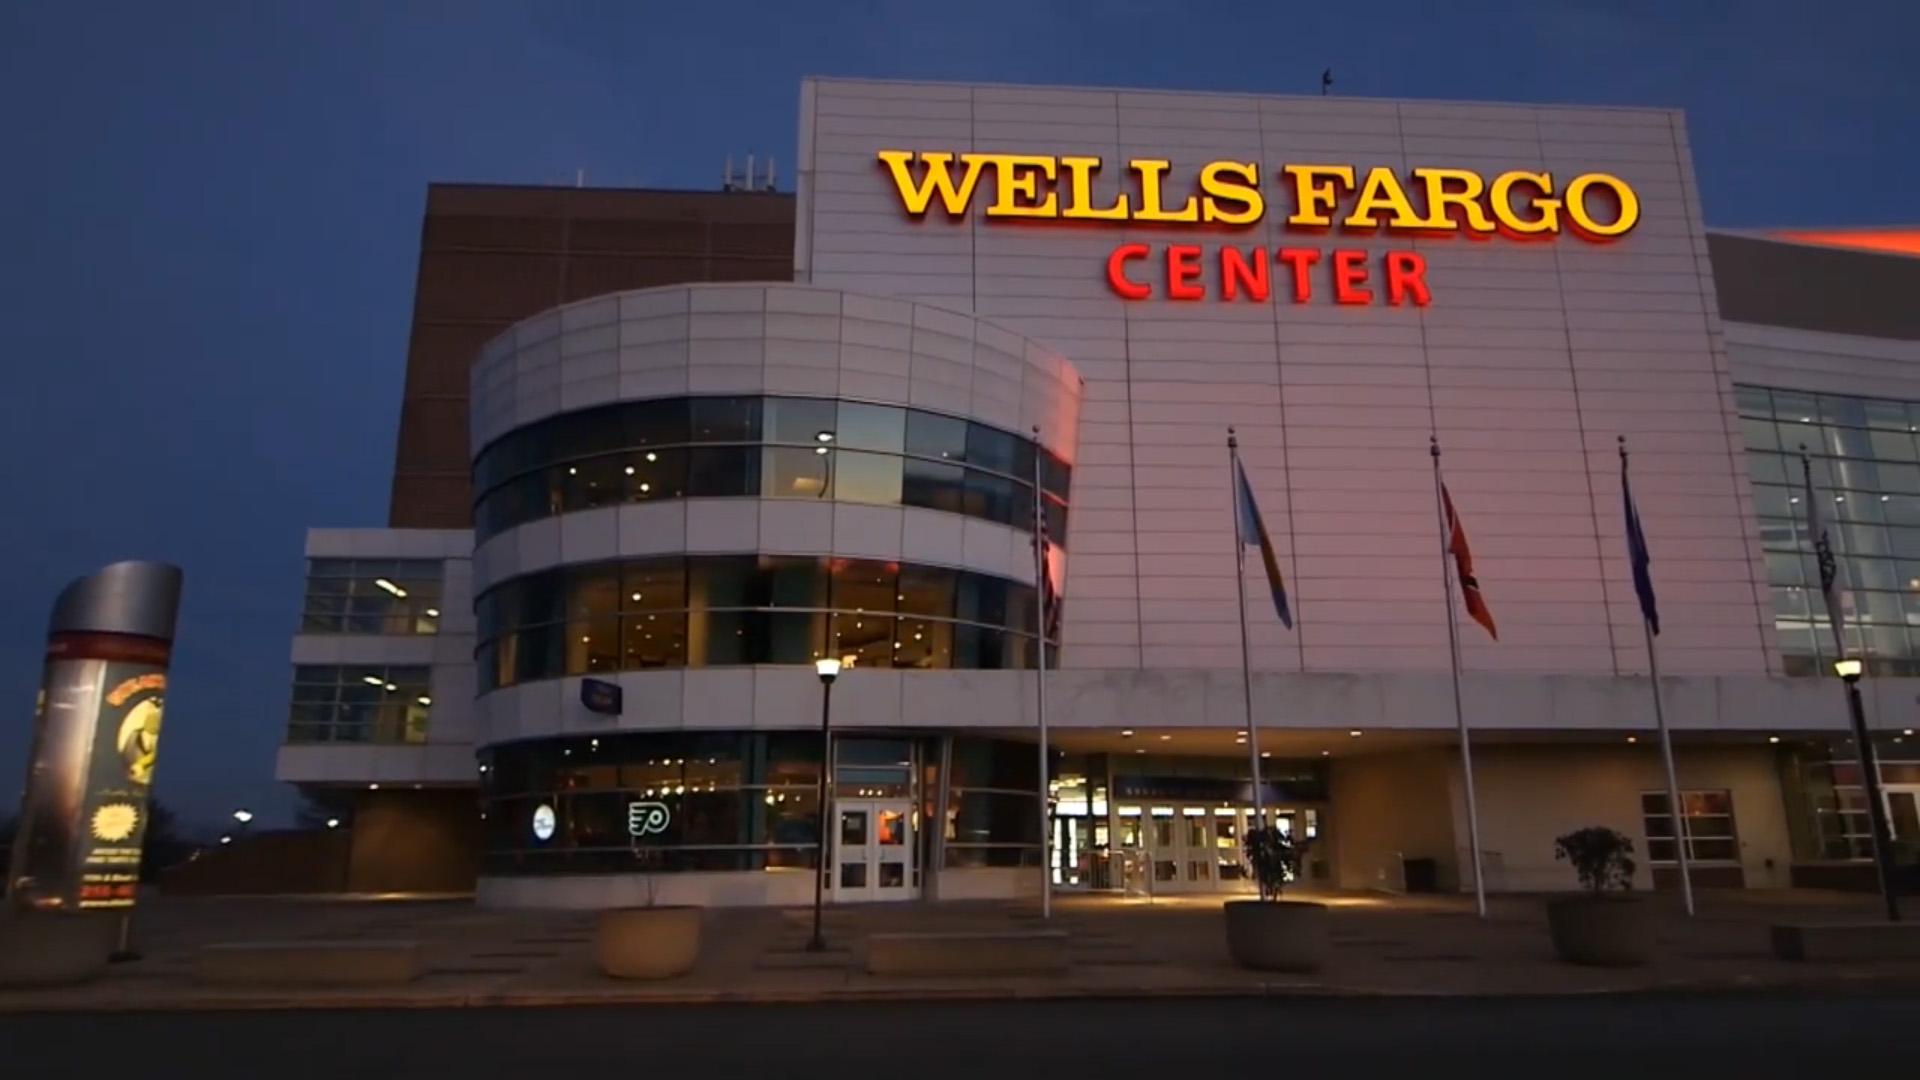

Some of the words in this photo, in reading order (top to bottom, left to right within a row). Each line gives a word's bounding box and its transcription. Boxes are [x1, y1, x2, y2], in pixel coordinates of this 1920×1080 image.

[878, 150, 1264, 225] WELLS
[1284, 164, 1640, 238] FARGO
[1106, 243, 1431, 307] CENTER
